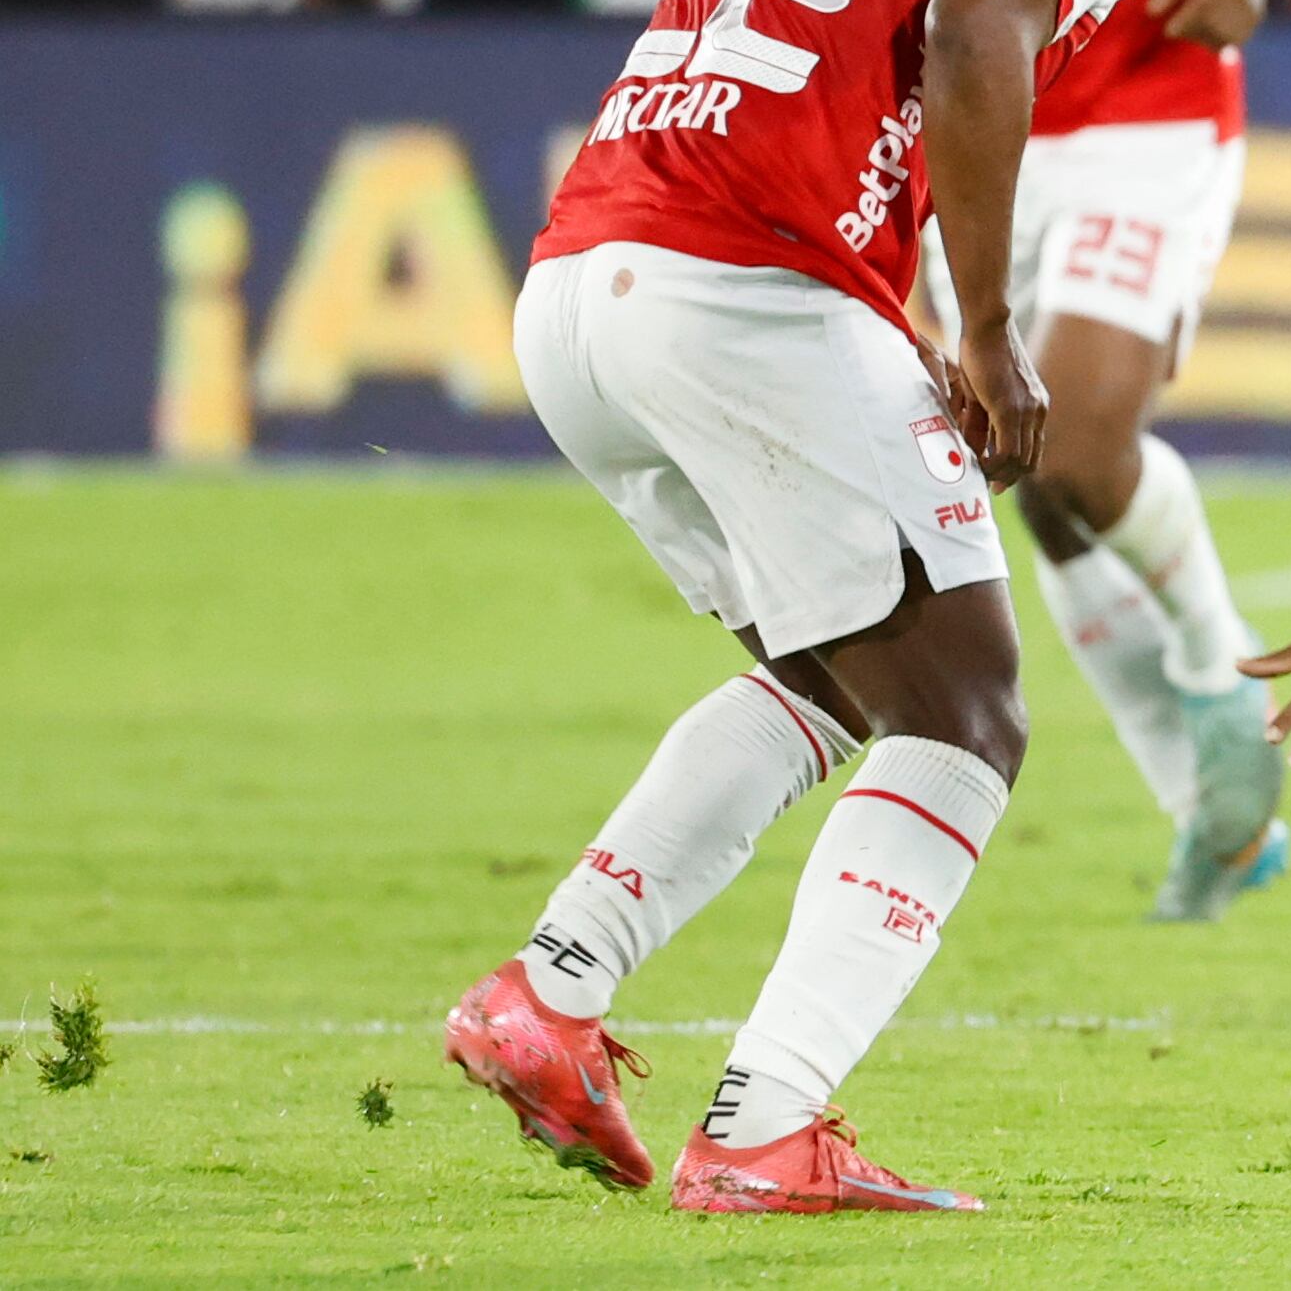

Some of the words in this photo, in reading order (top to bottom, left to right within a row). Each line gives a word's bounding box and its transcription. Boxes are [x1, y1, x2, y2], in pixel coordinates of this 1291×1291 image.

[587, 79, 740, 147] NECTAR
[834, 85, 923, 253] BetPla
[1064, 214, 1164, 298] 23
[934, 497, 987, 530] FILA
[838, 870, 936, 925] SANTA
